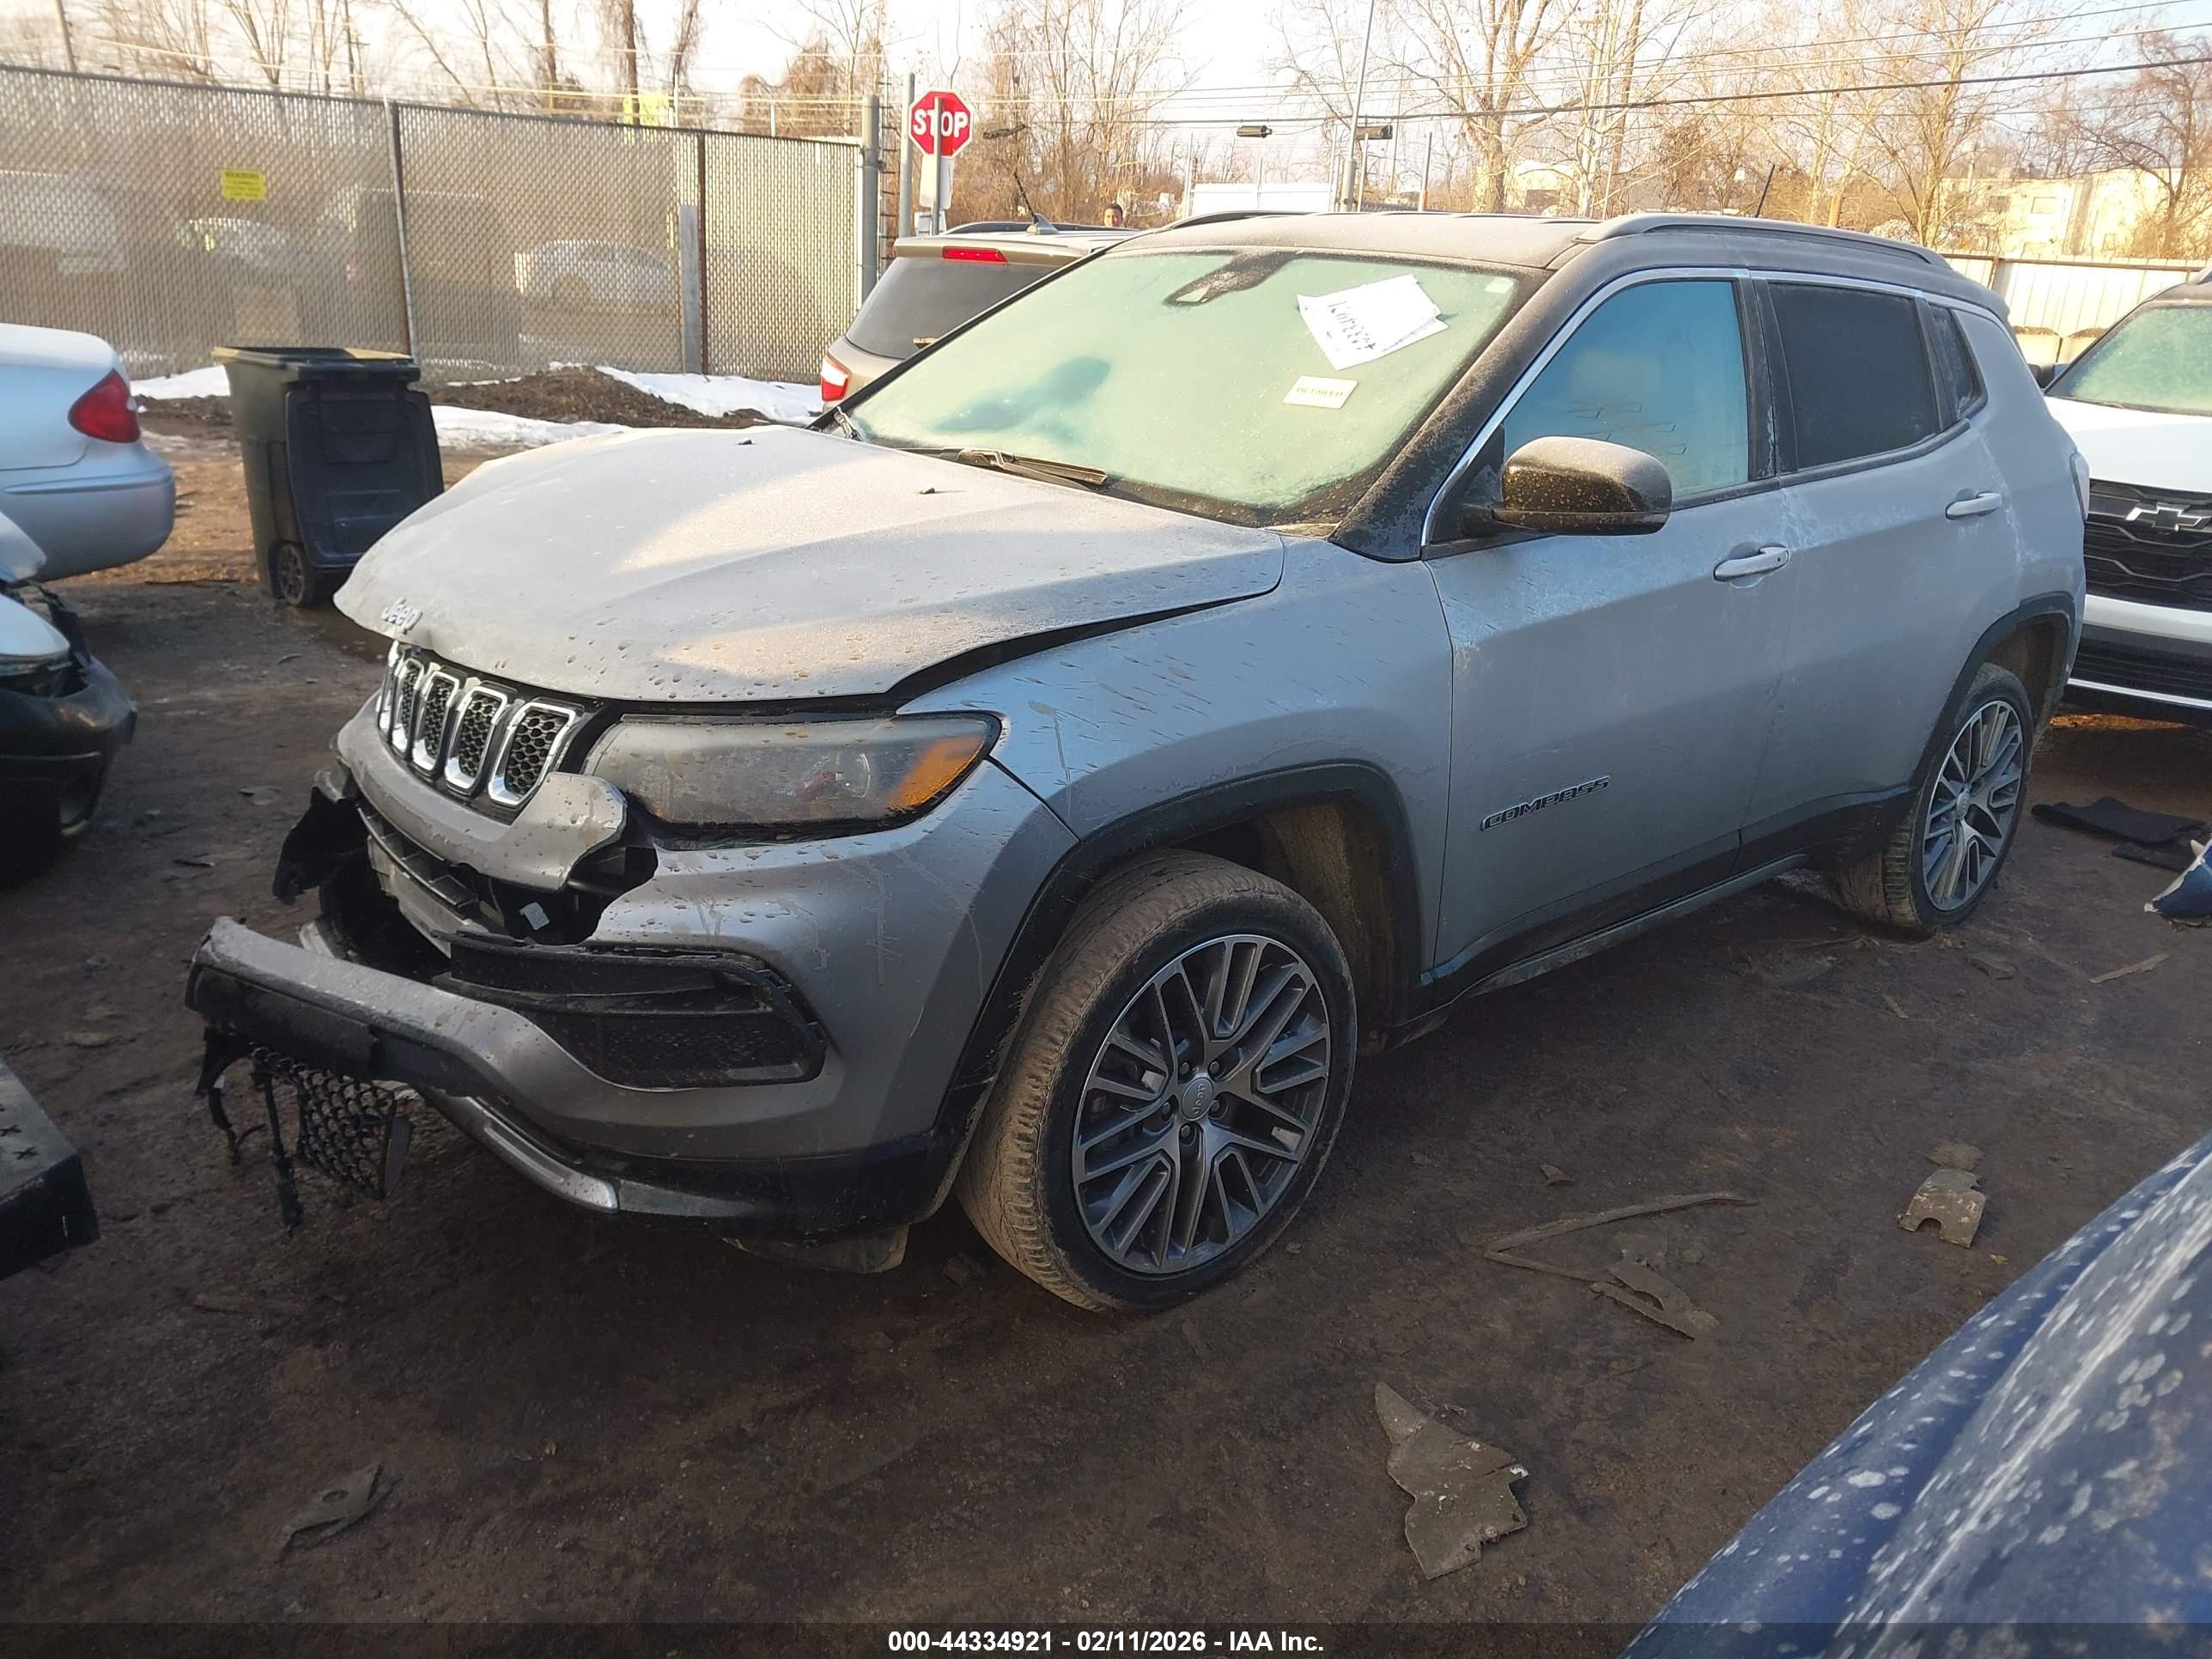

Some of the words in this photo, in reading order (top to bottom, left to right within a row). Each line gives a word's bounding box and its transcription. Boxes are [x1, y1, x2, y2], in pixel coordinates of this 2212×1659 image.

[913, 109, 968, 138] STOP
[381, 598, 423, 635] Jeep
[1480, 775, 1610, 830] COMPASS
